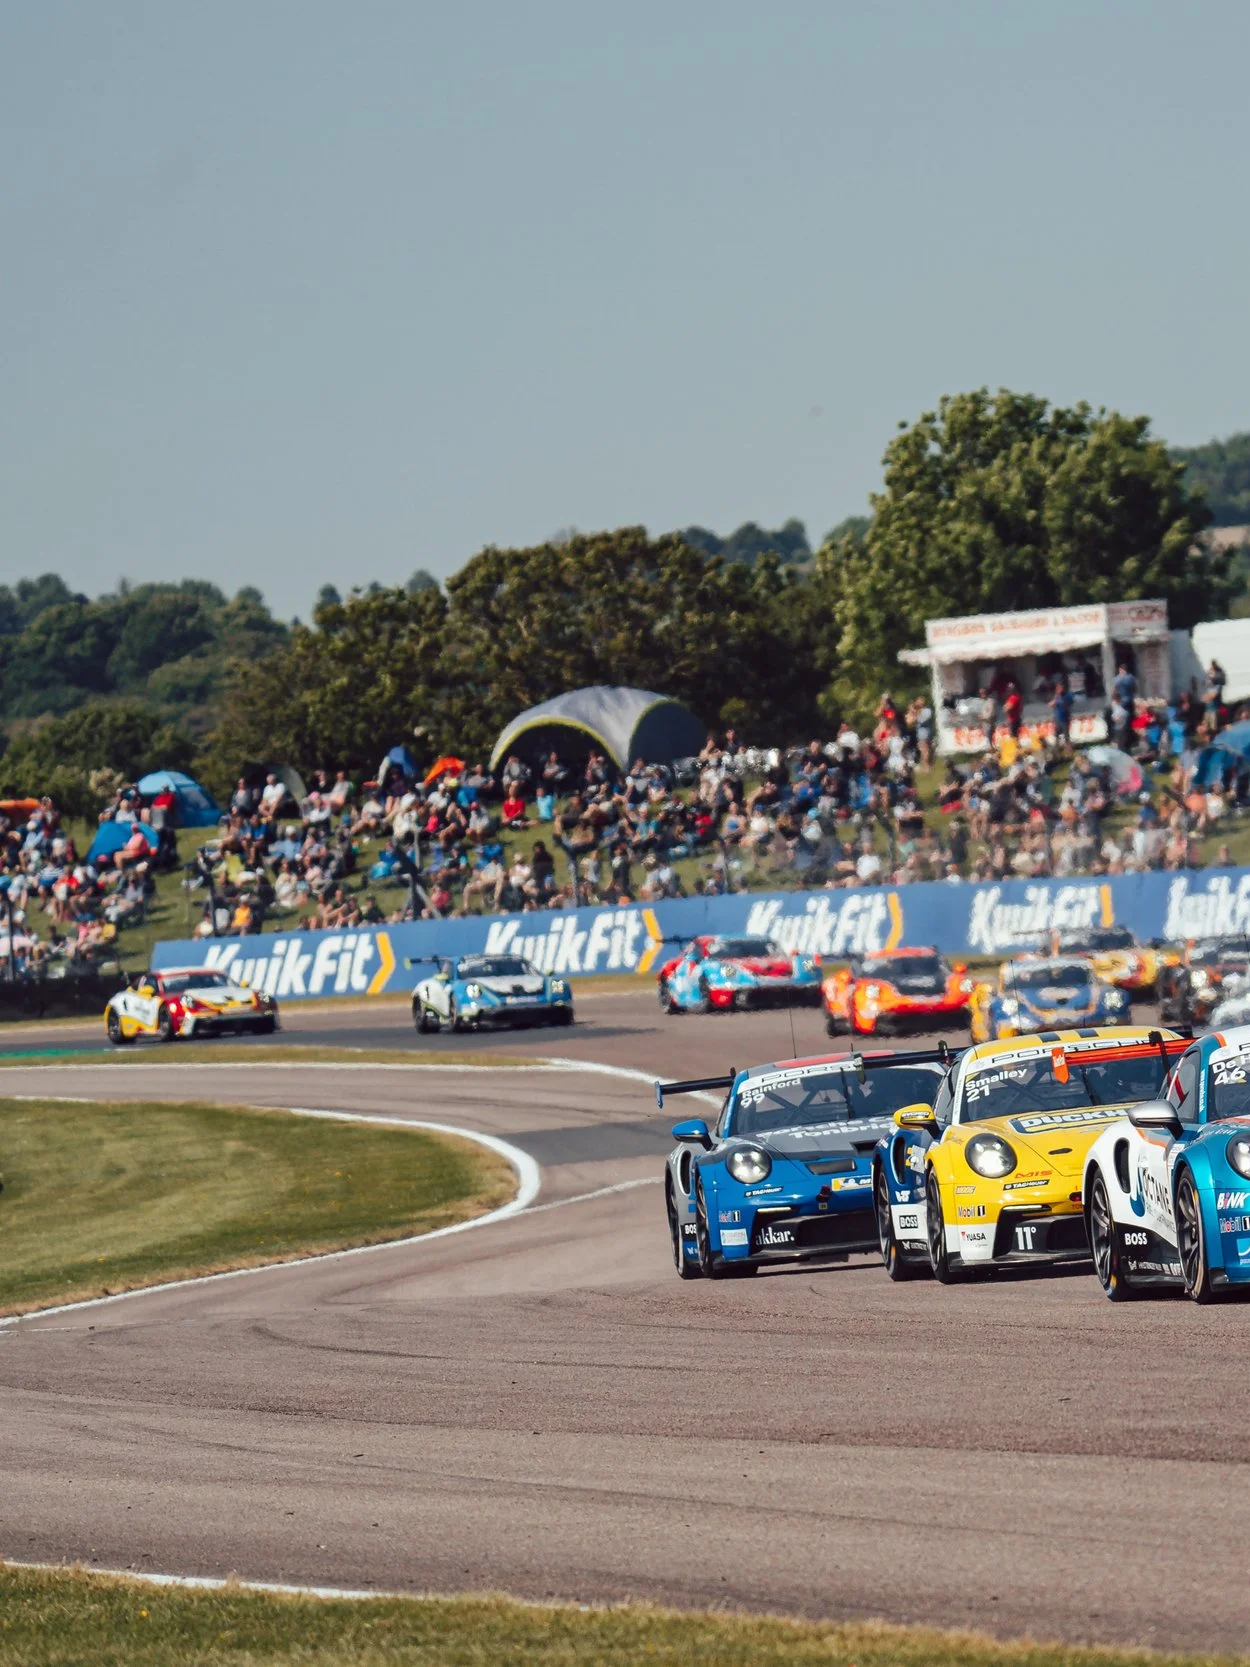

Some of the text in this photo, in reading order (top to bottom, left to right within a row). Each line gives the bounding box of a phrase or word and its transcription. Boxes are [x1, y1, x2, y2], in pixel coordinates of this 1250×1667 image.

[762, 1061, 852, 1083] PORS
[1212, 1060, 1236, 1075] De
[965, 1068, 1027, 1091] Smalley
[1214, 1068, 1246, 1086] 46
[742, 1078, 800, 1099] Rainford
[966, 1085, 990, 1102] 21
[740, 1092, 766, 1108] 99
[1020, 1109, 1127, 1128] DUCKH
[733, 1210, 740, 1222] 1
[958, 1204, 986, 1218] Mobil 1
[684, 1224, 696, 1235] BOS
[900, 1216, 918, 1229] BOSS
[1220, 1216, 1241, 1234] Mobil
[755, 1226, 796, 1246] akkar.
[966, 1232, 987, 1242] YUASA
[1124, 1232, 1148, 1246] BOSS
